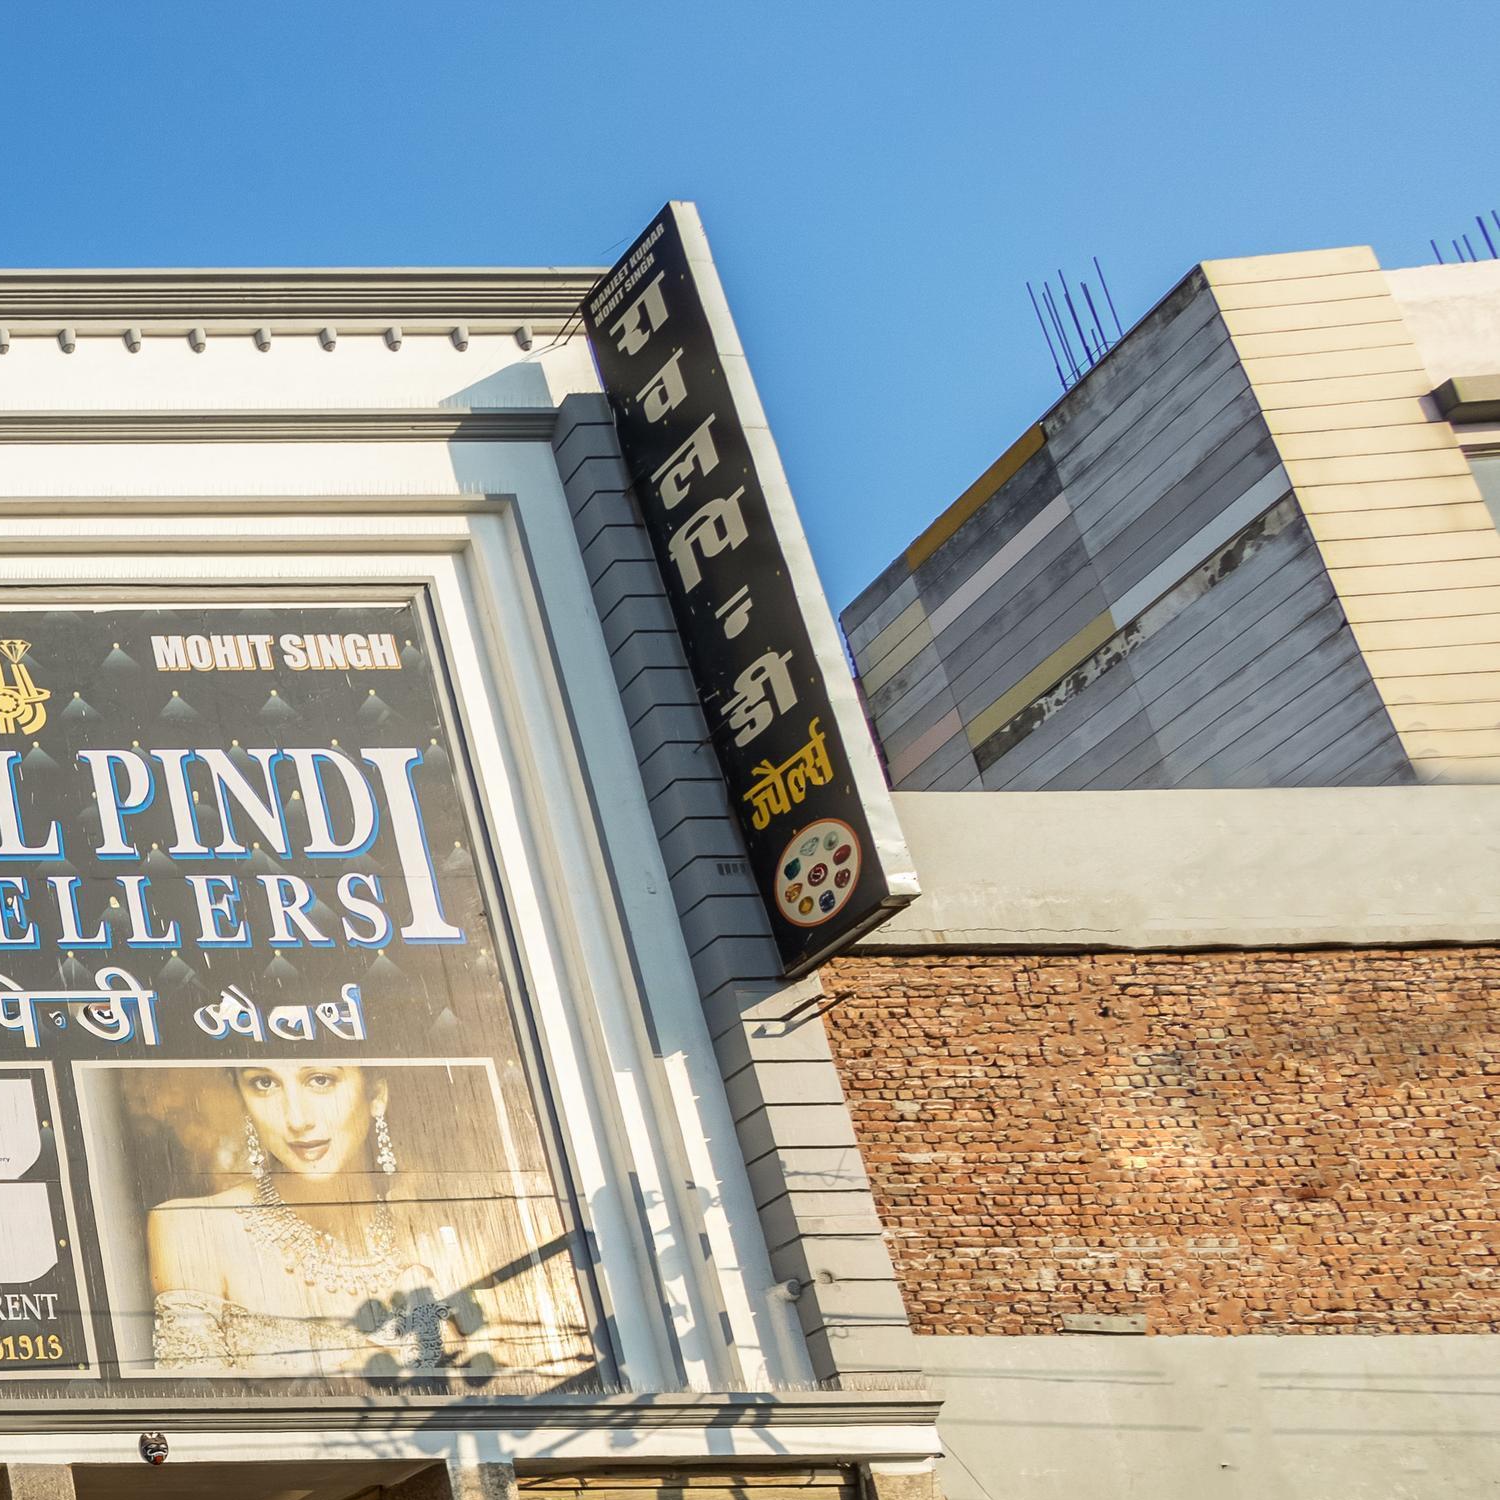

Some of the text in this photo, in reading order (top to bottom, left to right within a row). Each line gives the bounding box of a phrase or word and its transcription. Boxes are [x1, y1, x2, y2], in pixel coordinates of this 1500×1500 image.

[629, 222, 665, 267] KUMAR
[624, 252, 655, 292] SINGH
[151, 634, 403, 672] MOHIT SINGH
[76, 746, 468, 946] PINDI
